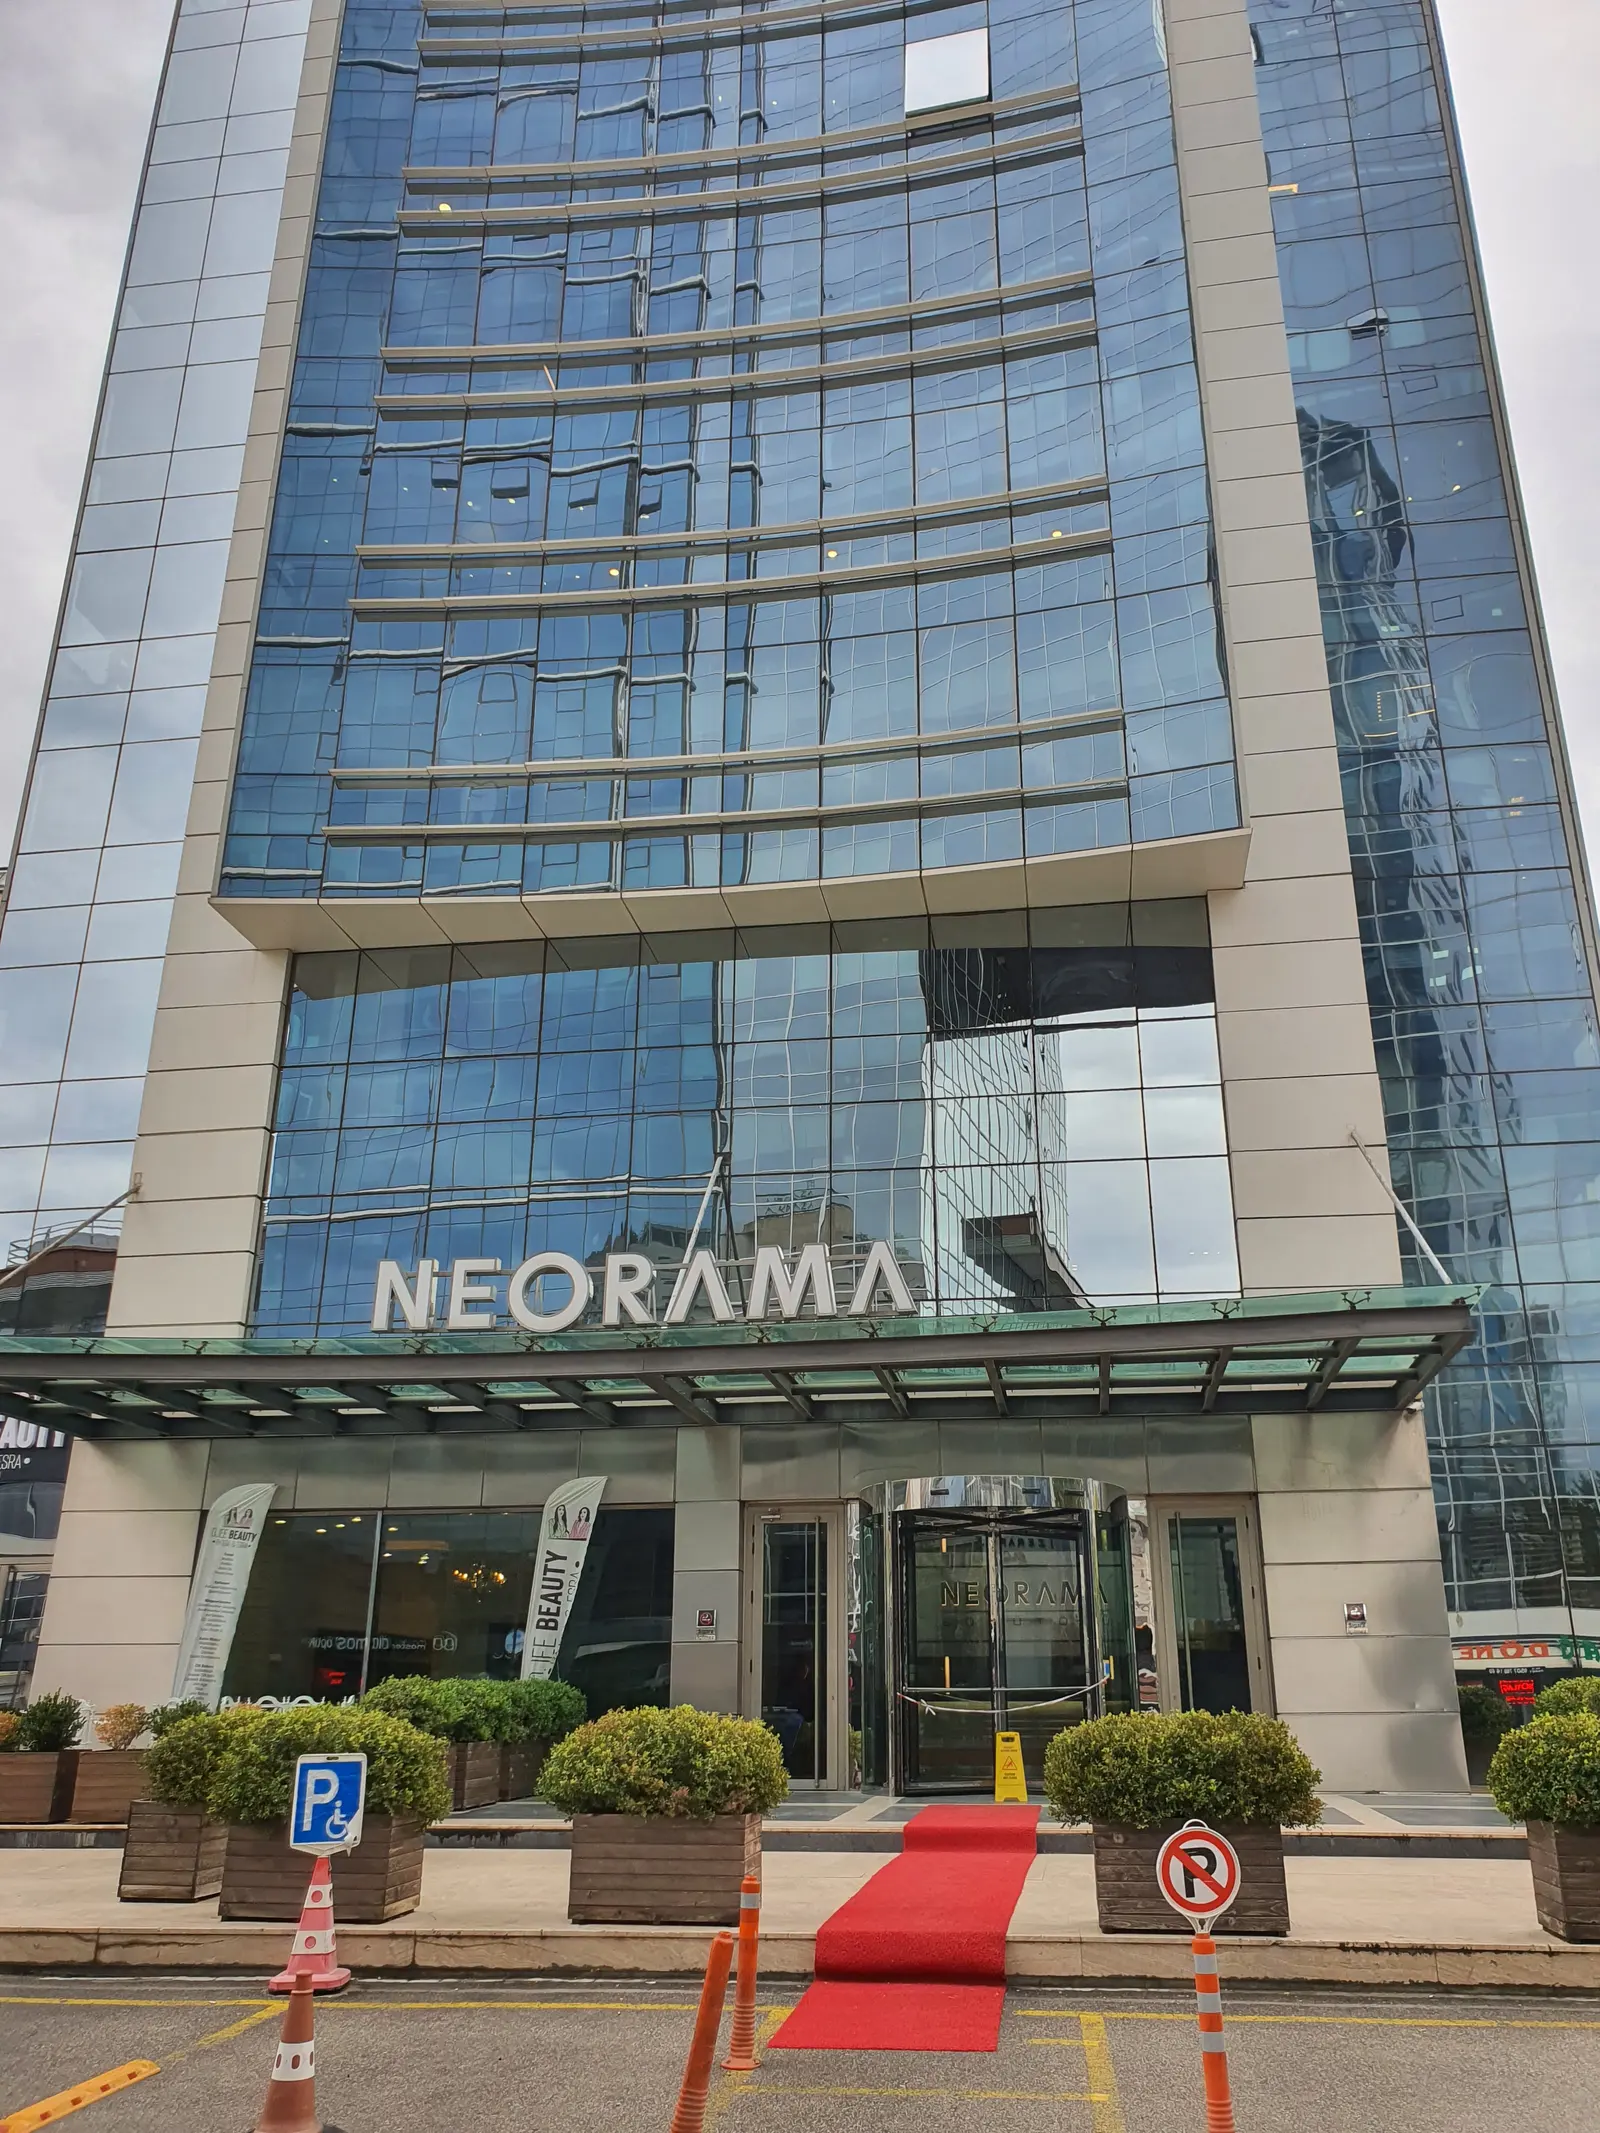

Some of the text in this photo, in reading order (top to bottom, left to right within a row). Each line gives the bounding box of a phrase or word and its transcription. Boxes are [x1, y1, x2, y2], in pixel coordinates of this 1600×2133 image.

[371, 1239, 919, 1333] NEORAMA
[229, 1529, 257, 1542] BEAUTY
[535, 1550, 568, 1631] BEAUTY
[302, 1769, 339, 1831] P
[1181, 1847, 1217, 1898] P
